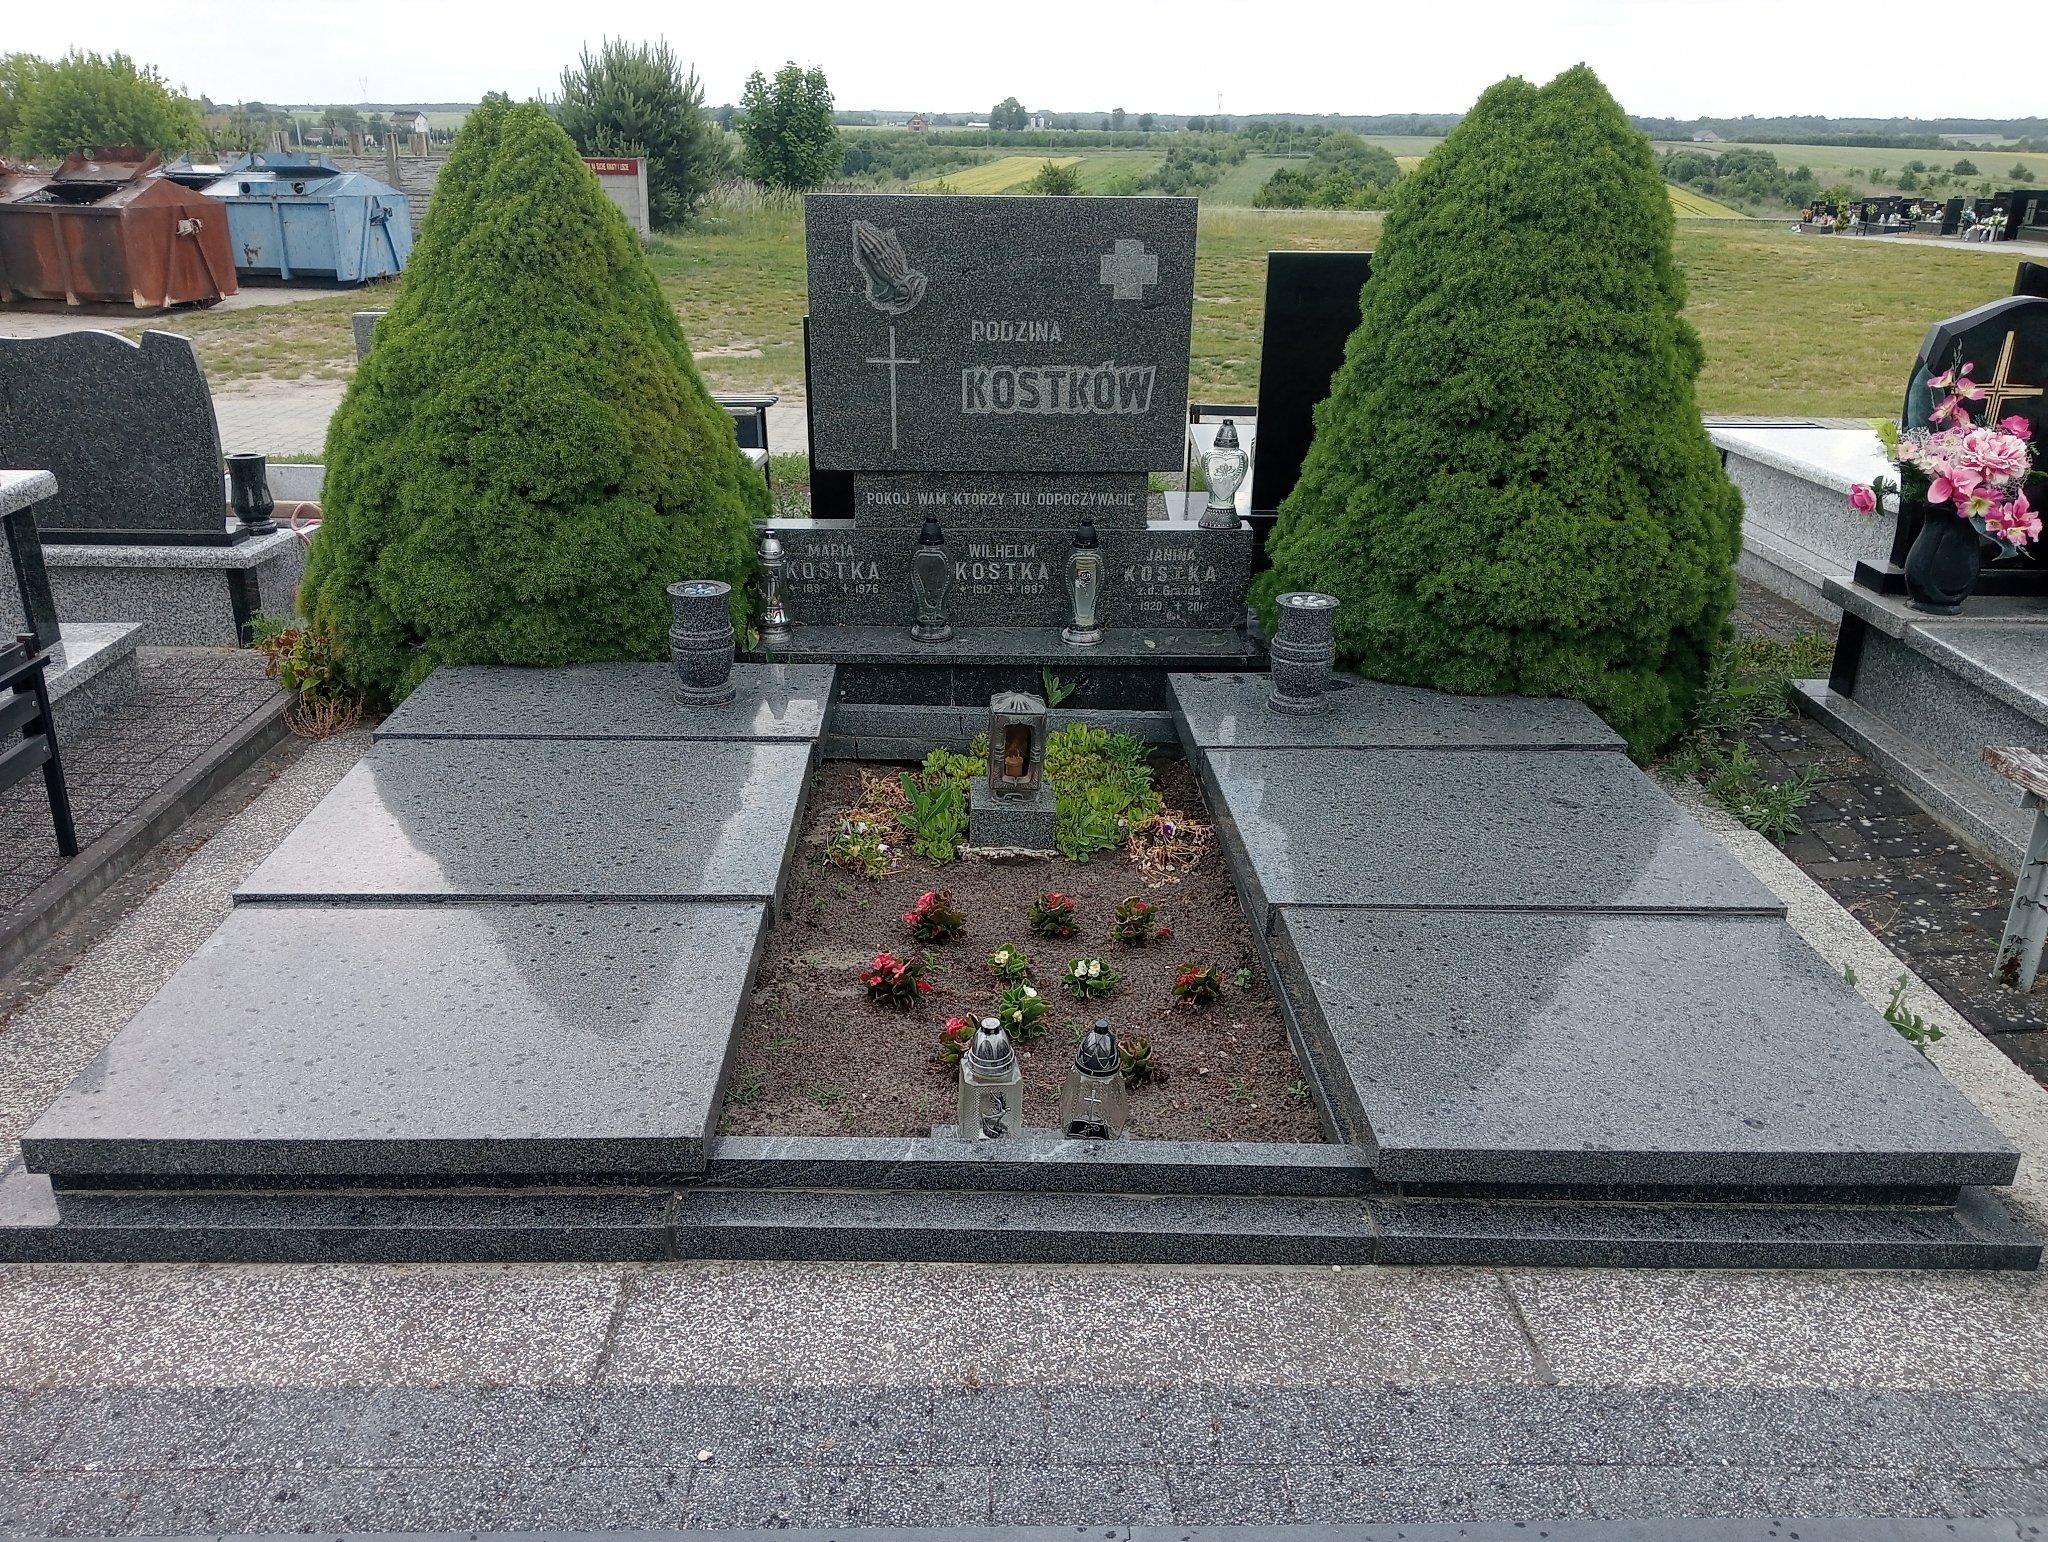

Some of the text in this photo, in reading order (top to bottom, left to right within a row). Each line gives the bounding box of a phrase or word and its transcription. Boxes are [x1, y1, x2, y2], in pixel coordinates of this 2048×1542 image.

[971, 320, 1063, 342] RODZINA
[961, 359, 1157, 415] KOSTKÓW
[917, 491, 947, 505] WAM
[1013, 492, 1030, 506] TU
[1037, 492, 1136, 507] ODPOCZYWACIE
[808, 543, 855, 557] MARIA
[968, 543, 1036, 558] WILHELM
[1146, 547, 1196, 561] JANINA
[786, 561, 881, 579] KOSTKA
[954, 561, 1049, 580] KOSTKA
[1123, 564, 1217, 582] KOSTKA
[855, 583, 879, 595] 1976
[972, 584, 1045, 595] 1917 1987
[1140, 601, 1162, 611] 1920
